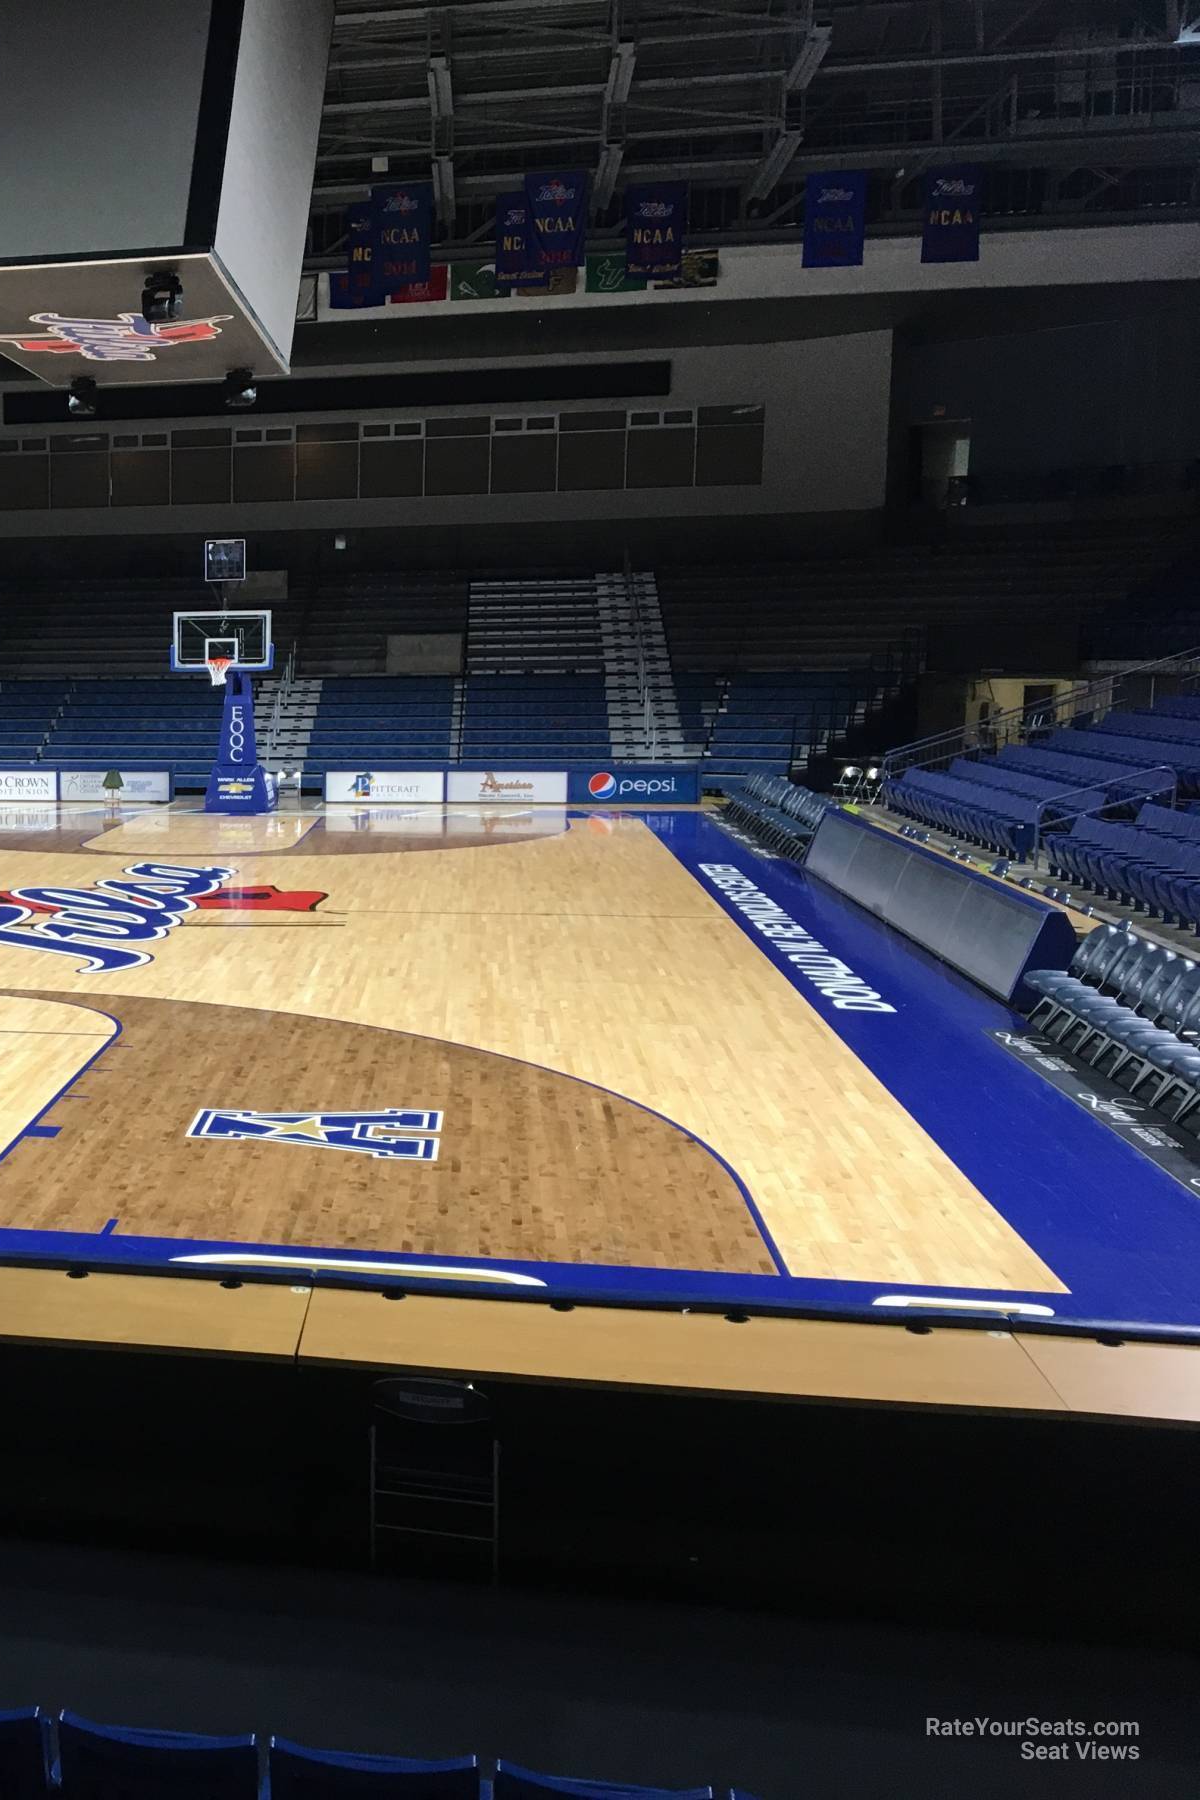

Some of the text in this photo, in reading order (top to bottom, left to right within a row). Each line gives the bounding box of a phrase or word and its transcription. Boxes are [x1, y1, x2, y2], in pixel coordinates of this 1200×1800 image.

[535, 215, 576, 234] NCAA
[929, 208, 974, 226] NCAA
[380, 226, 420, 245] NCAA
[633, 226, 674, 245] NCAA
[230, 706, 245, 762] EOOC
[5, 776, 49, 788] CROWN
[371, 784, 420, 793] PITTCRAFT
[619, 775, 676, 796] pepsi
[698, 863, 759, 891] CENTER
[724, 890, 814, 940] REYNOLDS
[788, 954, 898, 1013] DONALD
